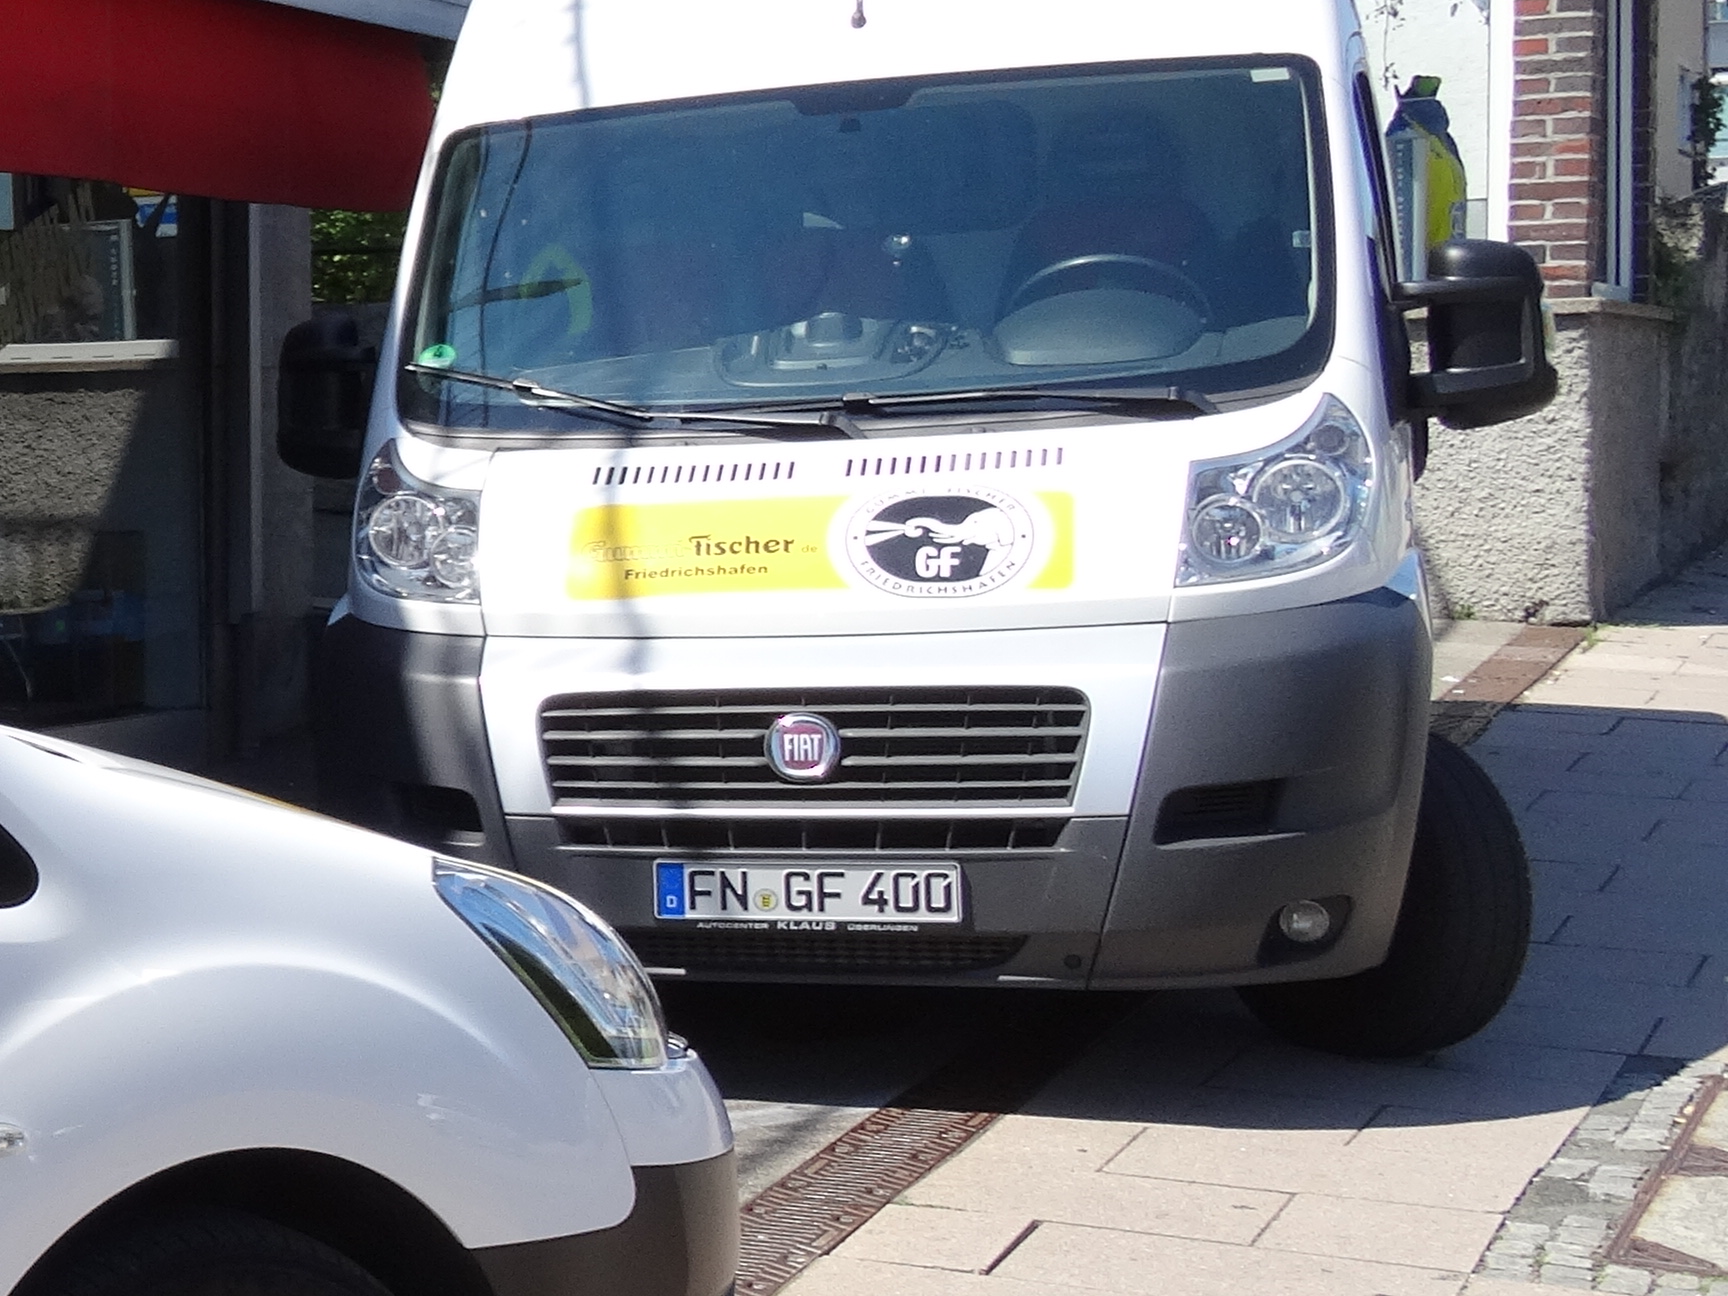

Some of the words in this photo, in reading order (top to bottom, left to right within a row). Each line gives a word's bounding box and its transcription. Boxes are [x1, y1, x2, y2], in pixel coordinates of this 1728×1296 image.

[623, 563, 769, 581] Friedrichshafen
[915, 546, 962, 579] GF
[860, 560, 1016, 595] FRIEDRICHSHAFEN
[783, 733, 822, 762] FIAT
[666, 896, 678, 908] D
[688, 869, 749, 912] FN
[783, 870, 846, 913] GF
[860, 871, 953, 914] 400
[777, 920, 838, 932] KLAUS
